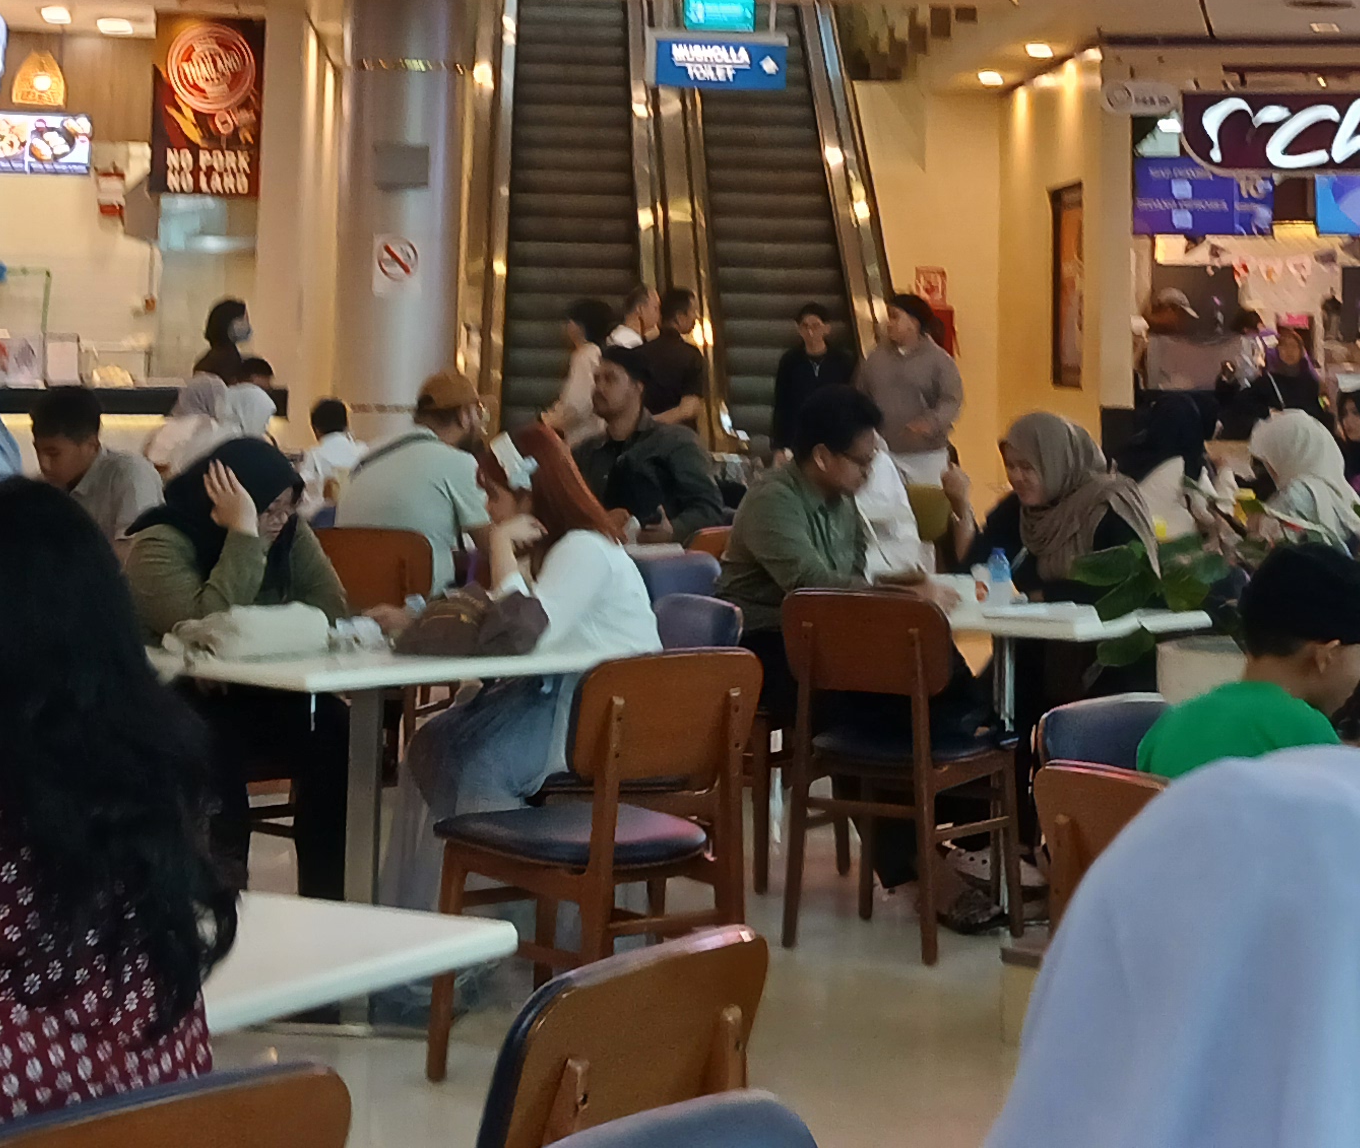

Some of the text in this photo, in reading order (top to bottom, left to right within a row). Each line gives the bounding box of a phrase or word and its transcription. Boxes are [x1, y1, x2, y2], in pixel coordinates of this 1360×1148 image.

[672, 43, 750, 64] MUSHOLLA
[686, 64, 735, 82] TOILET
[166, 148, 250, 173] NO PORK
[167, 170, 193, 193] NO
